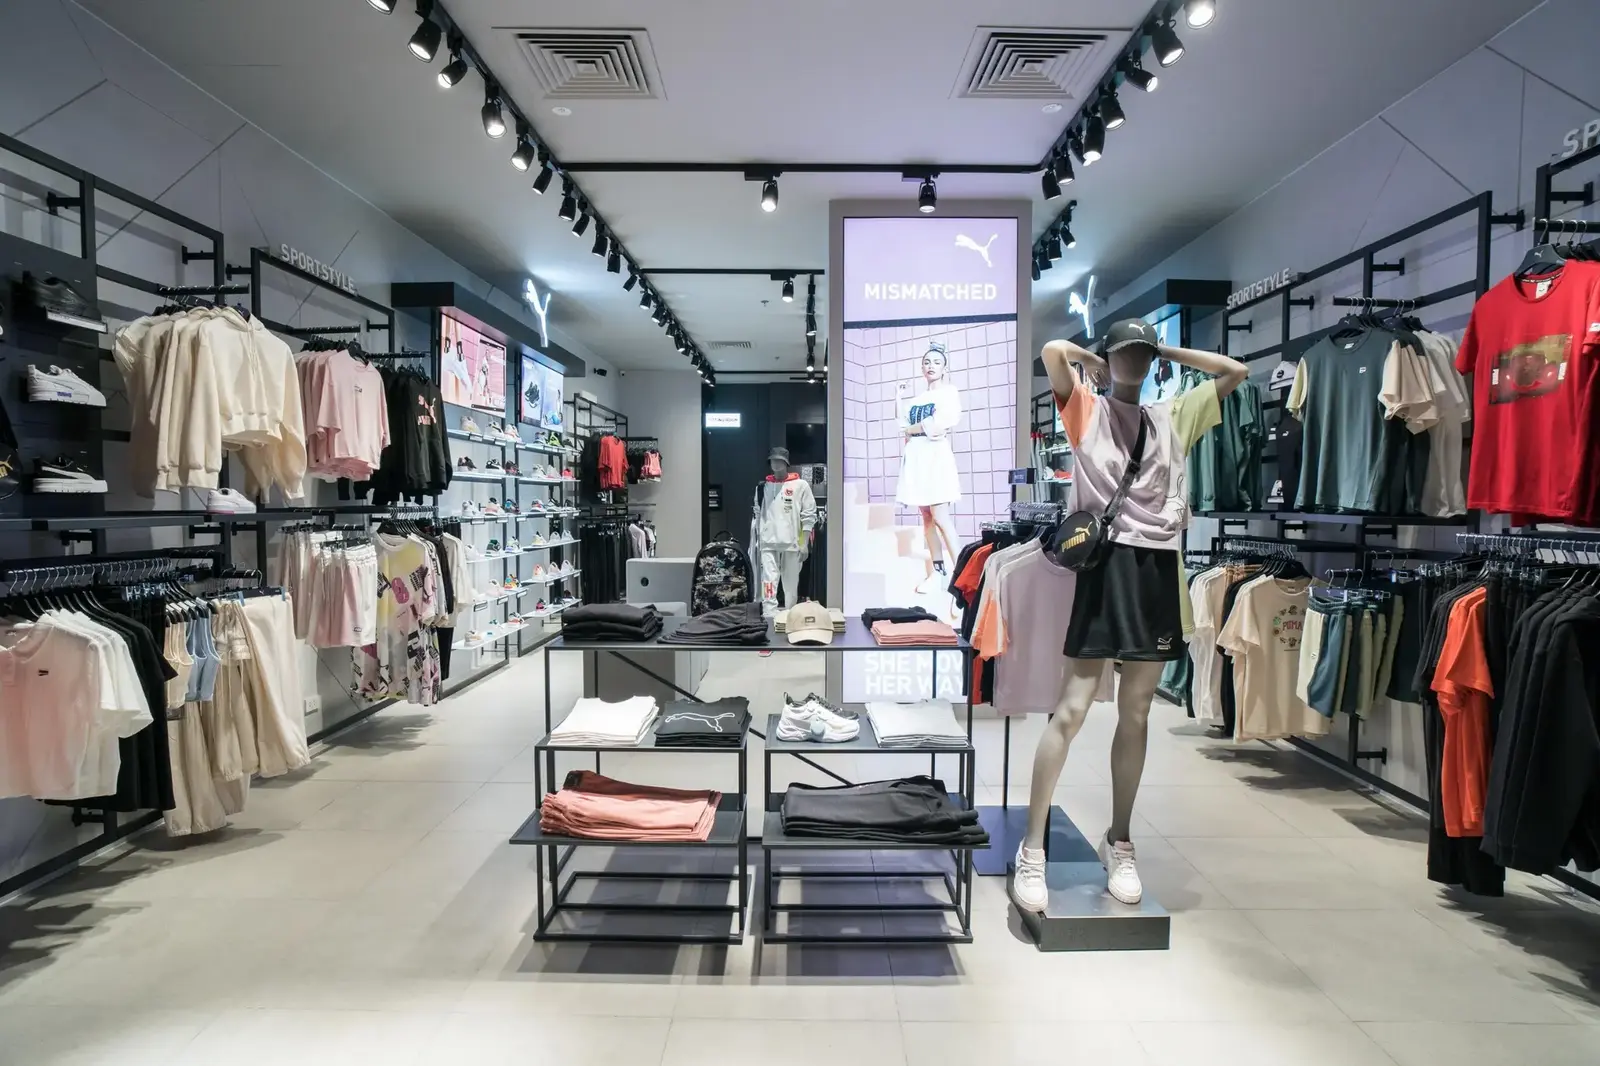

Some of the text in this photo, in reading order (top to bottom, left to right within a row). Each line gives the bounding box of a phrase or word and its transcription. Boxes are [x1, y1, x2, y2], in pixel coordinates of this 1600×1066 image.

[281, 243, 356, 295] SPORTSTYLE
[864, 282, 998, 301] MISMATCHED
[1226, 267, 1291, 310] SPORTSTYLE
[864, 651, 911, 673] SHE
[865, 675, 912, 696] HER
